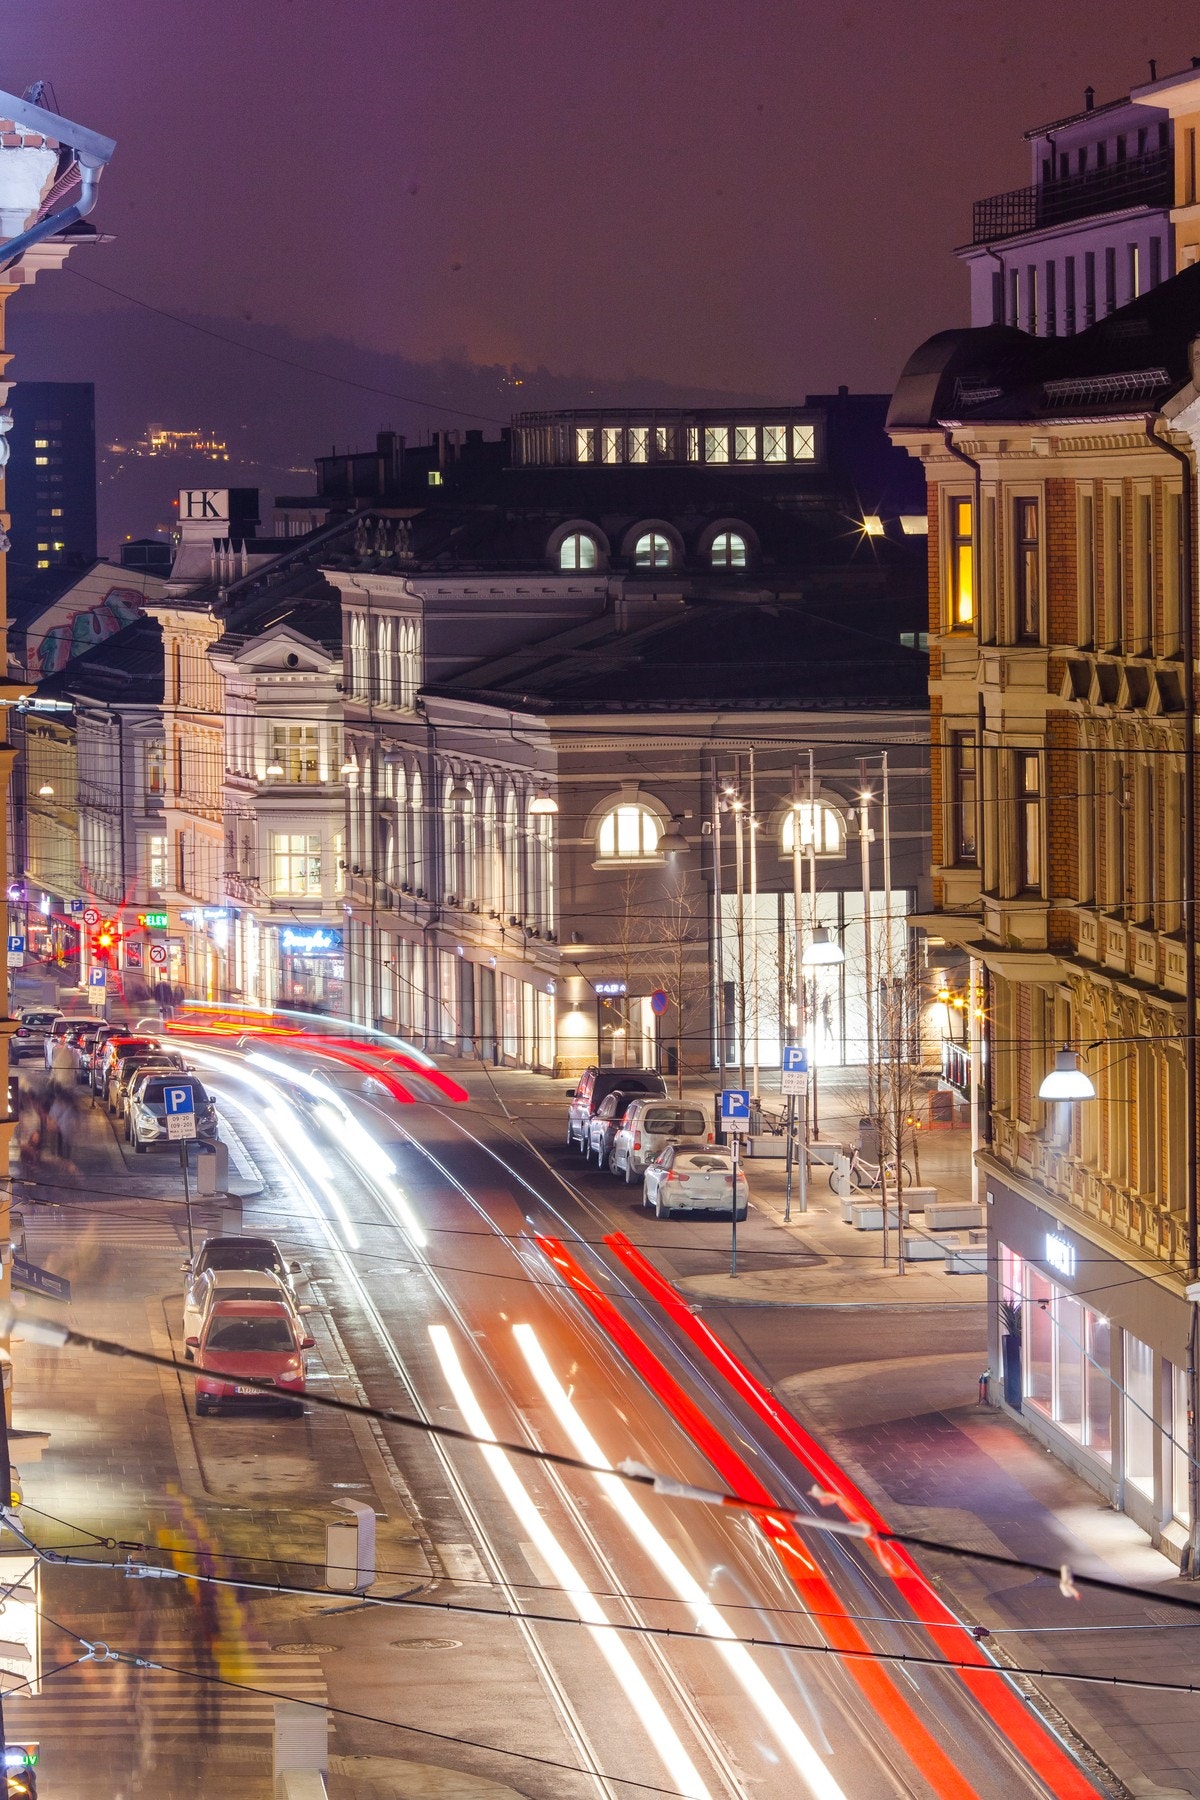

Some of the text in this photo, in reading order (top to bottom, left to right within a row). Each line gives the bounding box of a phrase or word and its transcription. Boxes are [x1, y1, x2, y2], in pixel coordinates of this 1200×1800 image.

[186, 492, 221, 517] HK
[11, 938, 21, 951] P
[92, 969, 103, 985] P
[789, 1050, 802, 1068] P
[171, 1090, 186, 1111] P
[729, 1094, 744, 1114] P
